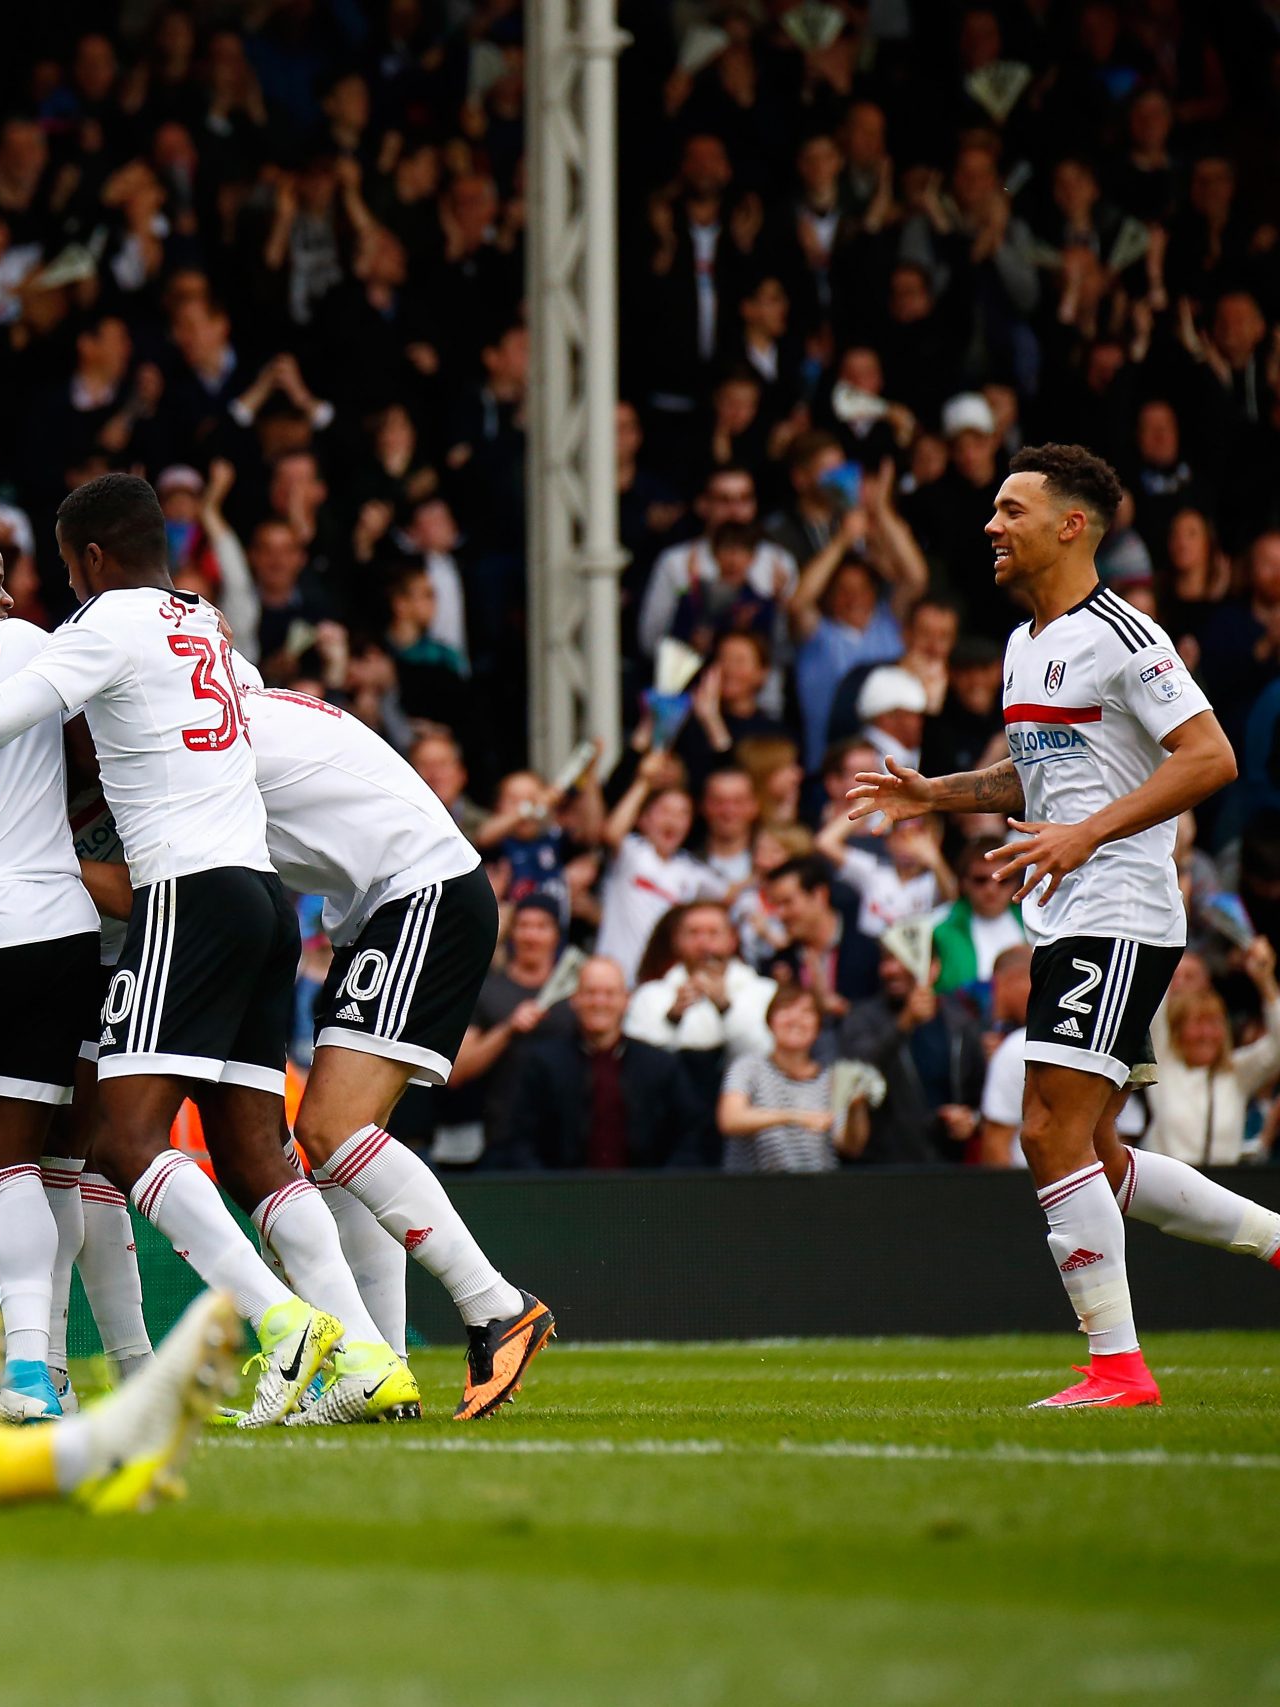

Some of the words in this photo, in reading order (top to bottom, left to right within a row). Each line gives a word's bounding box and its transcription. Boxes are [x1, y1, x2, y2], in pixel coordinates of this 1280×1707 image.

[1057, 957, 1103, 1015] 2
[335, 1012, 365, 1023] adidas
[1052, 1026, 1084, 1039] adidas
[1059, 1252, 1104, 1272] adidas
